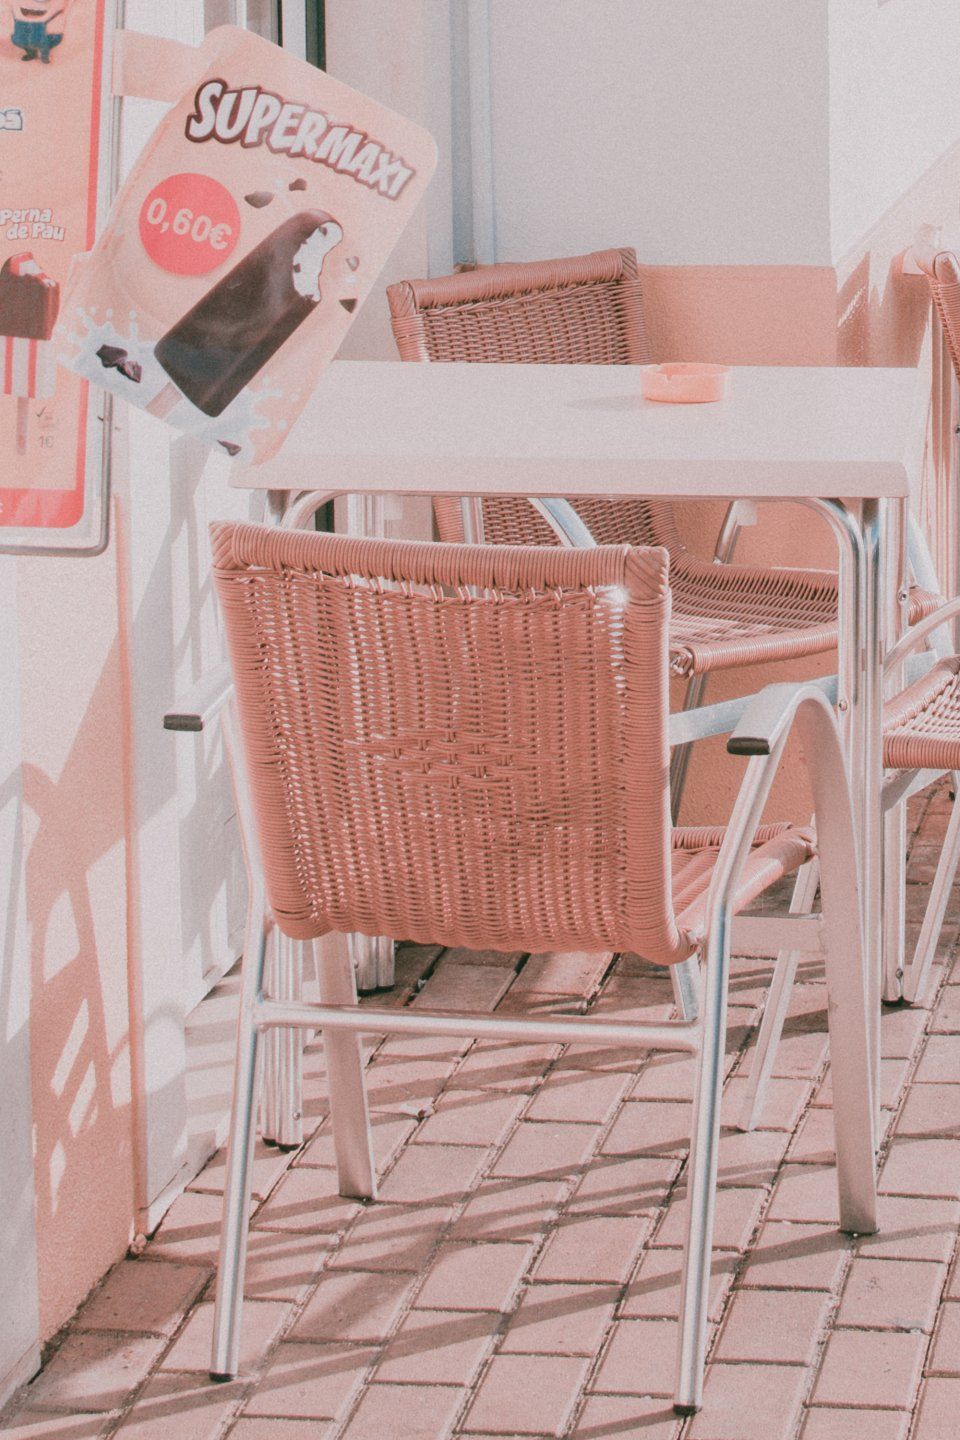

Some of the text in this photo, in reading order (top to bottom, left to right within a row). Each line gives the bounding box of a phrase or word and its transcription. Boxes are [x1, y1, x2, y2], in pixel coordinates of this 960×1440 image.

[185, 78, 416, 201] SUPERMAXI
[6, 222, 29, 240] de
[146, 197, 232, 251] 0,60€
